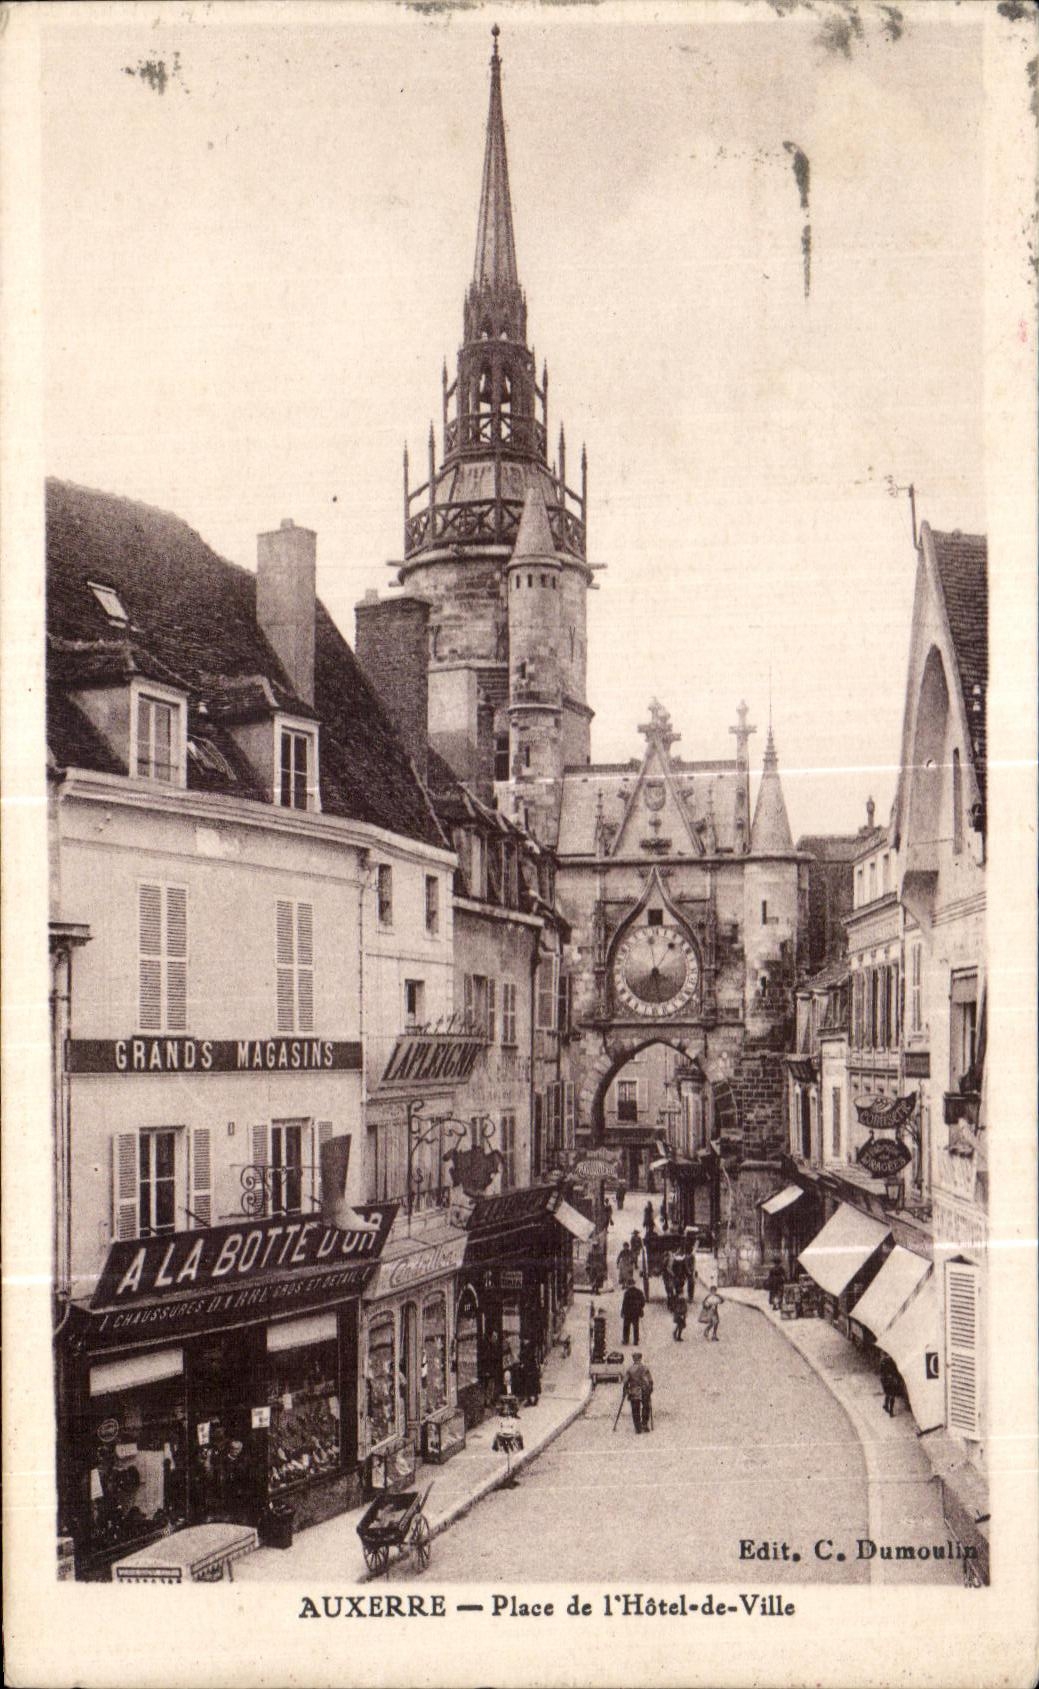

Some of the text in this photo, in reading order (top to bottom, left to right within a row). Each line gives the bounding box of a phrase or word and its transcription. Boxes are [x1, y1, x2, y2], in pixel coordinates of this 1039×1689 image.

[115, 1040, 334, 1070] GRANDS MAGASINS
[116, 1247, 147, 1295] A
[154, 1238, 205, 1288] LA
[212, 1223, 318, 1277] BOTTE
[112, 1300, 205, 1328] CHAUSSURES
